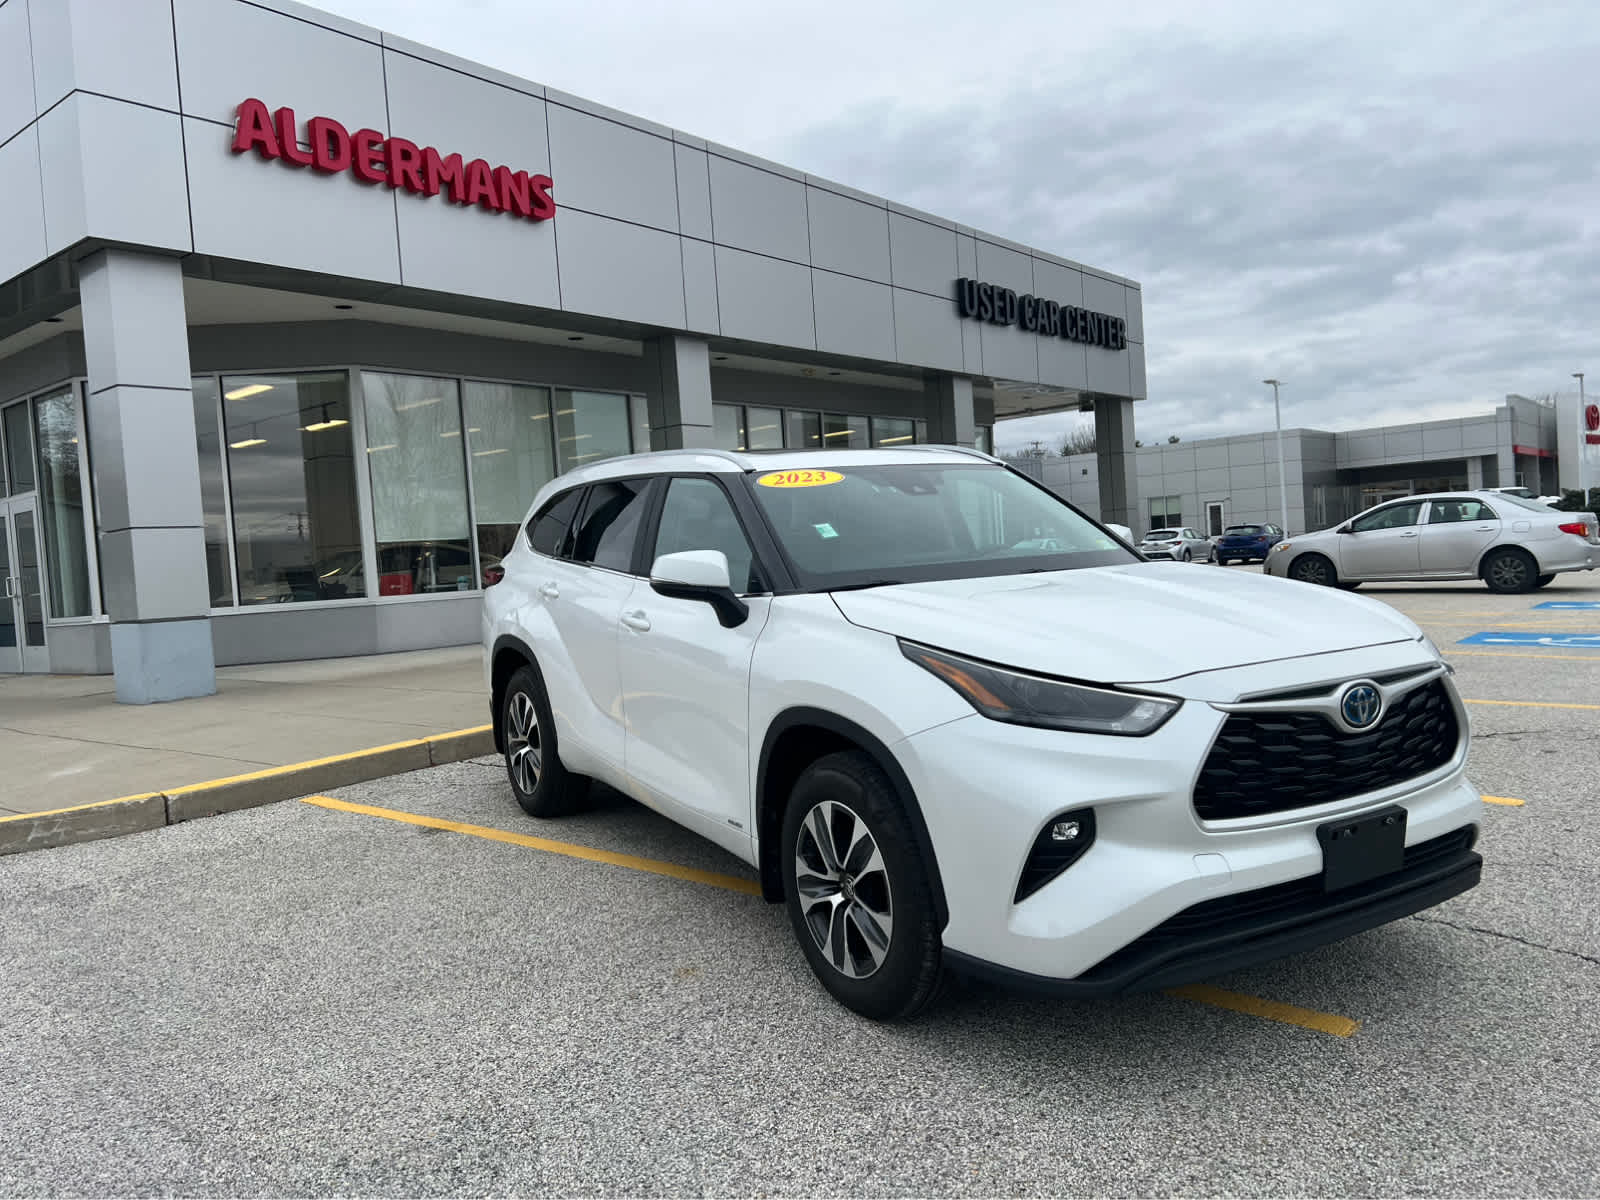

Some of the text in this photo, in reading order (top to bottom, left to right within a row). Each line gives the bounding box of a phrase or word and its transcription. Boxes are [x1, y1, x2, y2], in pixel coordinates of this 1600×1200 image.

[231, 97, 556, 222] ALDERMANS
[957, 277, 1127, 350] USED CAR CENTER
[774, 471, 826, 485] 2023
